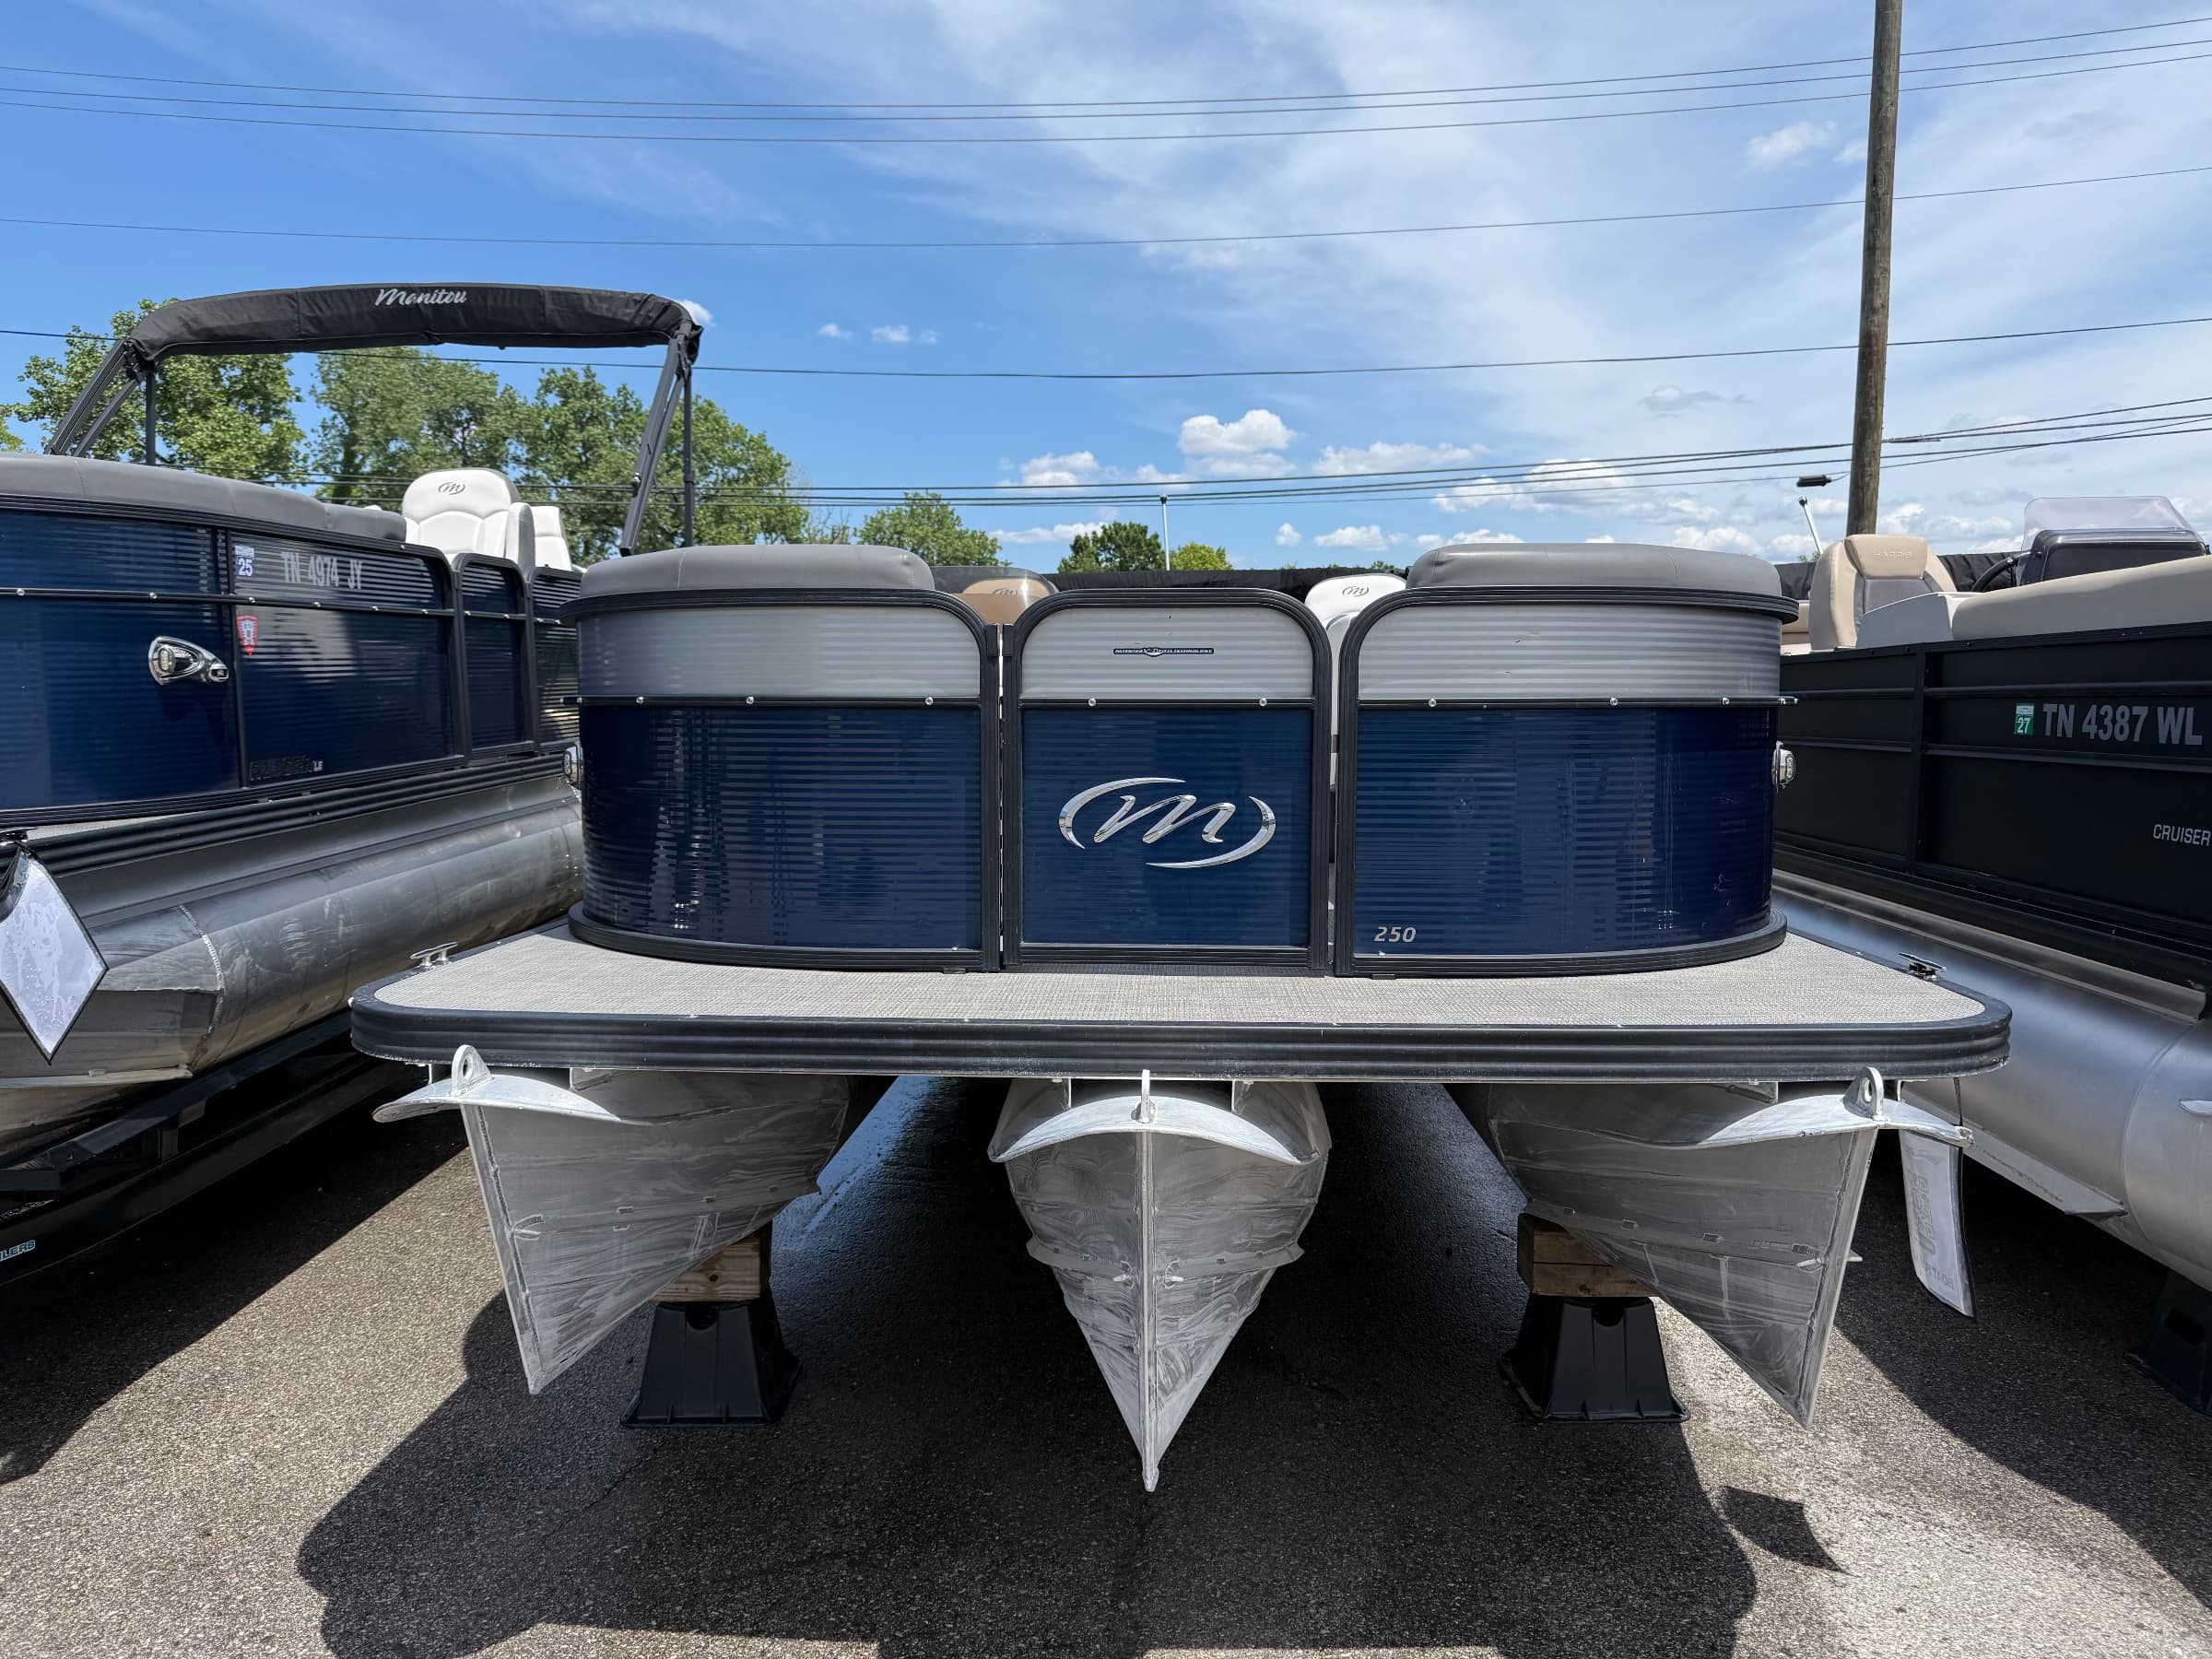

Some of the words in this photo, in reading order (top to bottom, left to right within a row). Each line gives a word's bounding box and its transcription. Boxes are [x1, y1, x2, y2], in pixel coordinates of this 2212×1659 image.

[374, 288, 467, 306] Manitou
[280, 551, 301, 582] TN
[308, 556, 339, 587] 4974
[347, 559, 362, 589] JY
[2017, 716, 2031, 734] 27
[2042, 703, 2076, 738] TN
[2081, 704, 2148, 743] 4387
[2157, 706, 2203, 746] WL
[2153, 824, 2211, 846] CRUISER
[1373, 925, 1417, 943] 250
